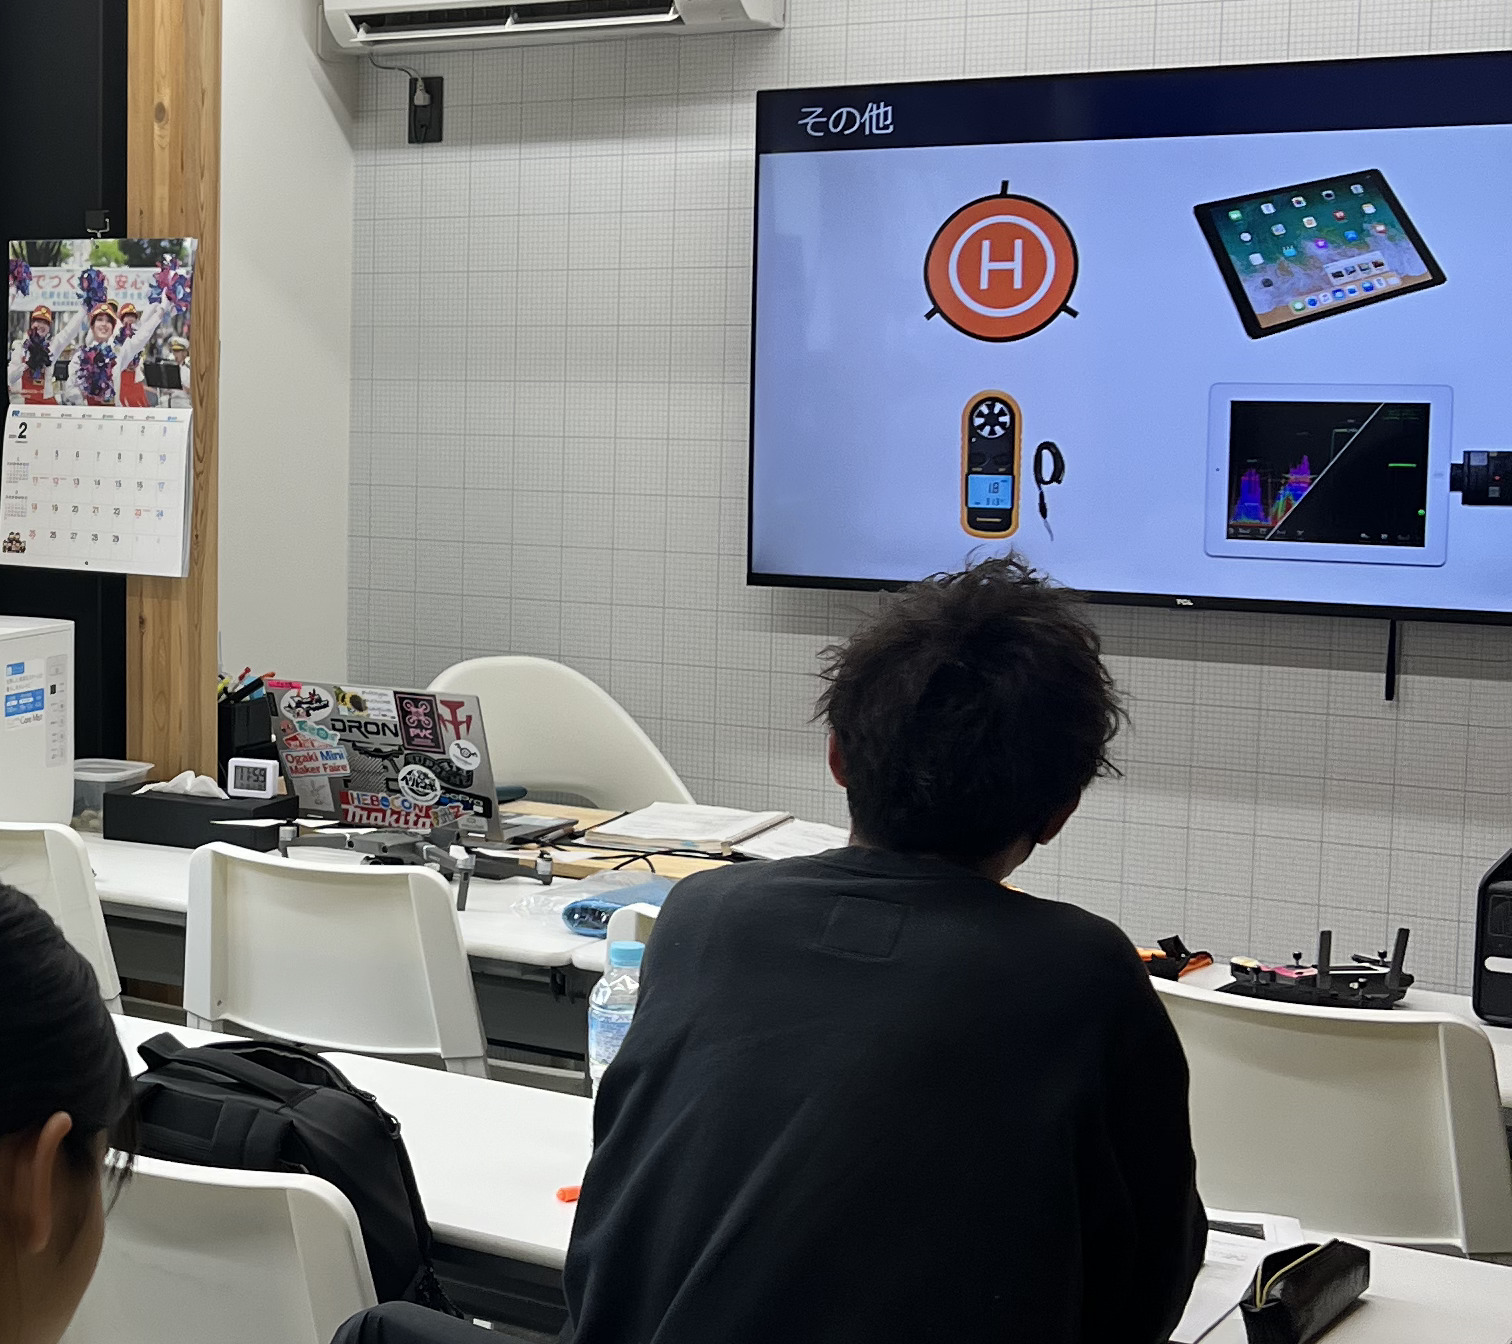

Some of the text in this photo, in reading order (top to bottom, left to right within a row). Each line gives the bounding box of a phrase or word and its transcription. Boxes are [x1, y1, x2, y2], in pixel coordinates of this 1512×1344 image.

[797, 101, 894, 136] その他
[980, 239, 1023, 290] H
[18, 421, 28, 439] 2
[285, 749, 345, 765] Ogaki Mini
[289, 762, 348, 774] Maker Faire
[350, 792, 426, 816] HEBOCON
[346, 807, 432, 828] makita
